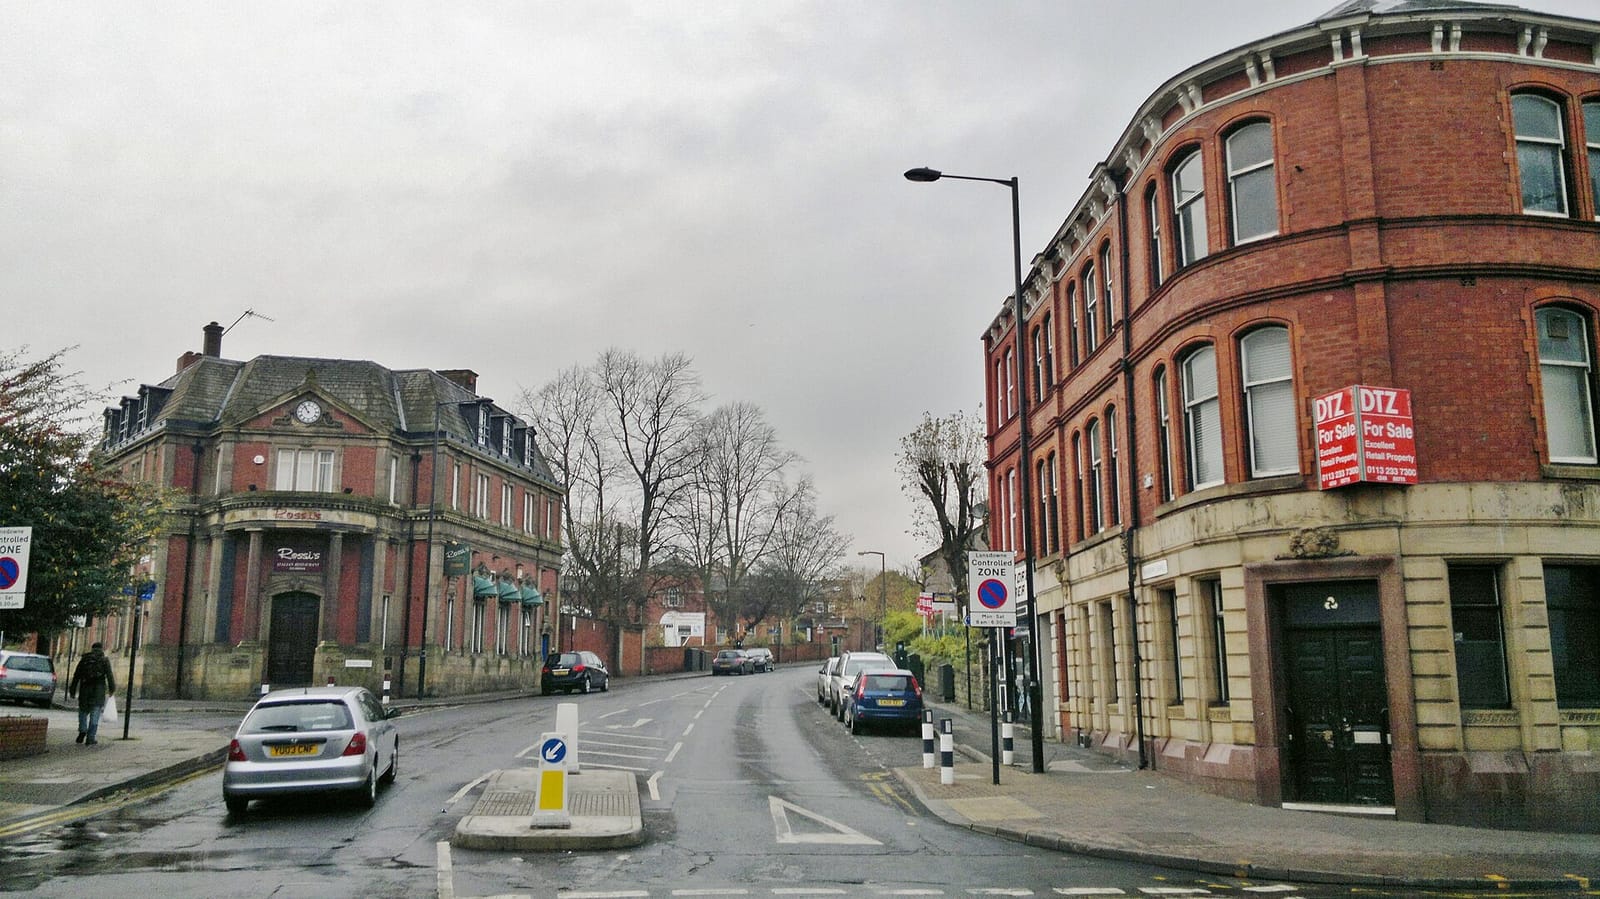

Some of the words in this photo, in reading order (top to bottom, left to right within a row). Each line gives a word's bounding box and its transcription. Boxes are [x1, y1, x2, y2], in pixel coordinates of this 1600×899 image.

[1316, 392, 1345, 422] DTZ
[1360, 388, 1399, 414] DTZ
[1319, 429, 1333, 445] For
[1335, 421, 1357, 440] Sale
[1363, 420, 1384, 436] For
[1387, 422, 1413, 439] Sale
[1320, 445, 1343, 457] Excellent
[1365, 440, 1395, 450] Excellent
[1321, 458, 1335, 468] Retail
[1335, 452, 1358, 465] Property
[1366, 451, 1385, 460] Retail
[1387, 453, 1415, 463] Property
[1367, 466, 1384, 474] 0113
[0, 545, 21, 554] ONE
[971, 559, 1013, 567] Controlled
[977, 568, 1007, 576] ZONE
